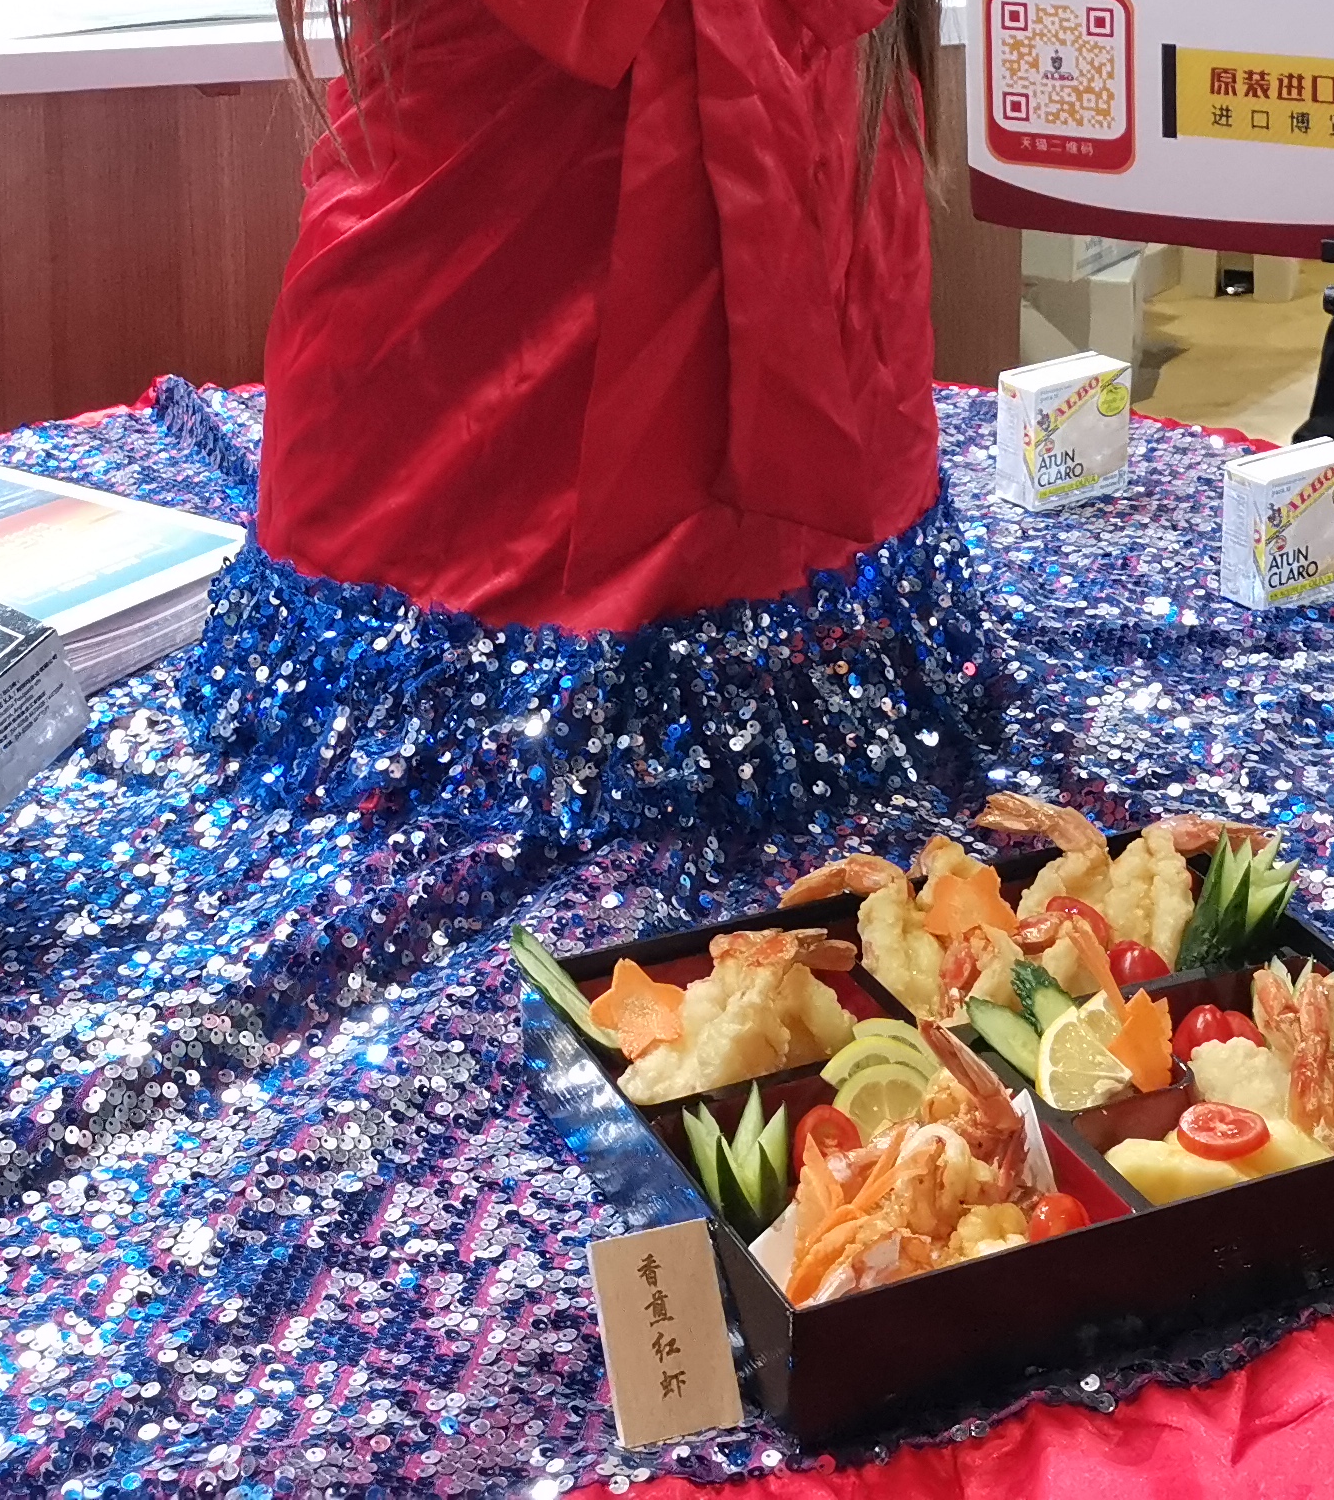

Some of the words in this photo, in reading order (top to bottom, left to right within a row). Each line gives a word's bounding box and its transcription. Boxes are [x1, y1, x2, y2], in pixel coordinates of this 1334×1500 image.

[1053, 376, 1100, 422] ALBO
[1038, 447, 1076, 473] ATUN
[1038, 462, 1084, 488] CLARO
[1268, 545, 1309, 571] ATUN
[1268, 561, 1319, 589] CLARO
